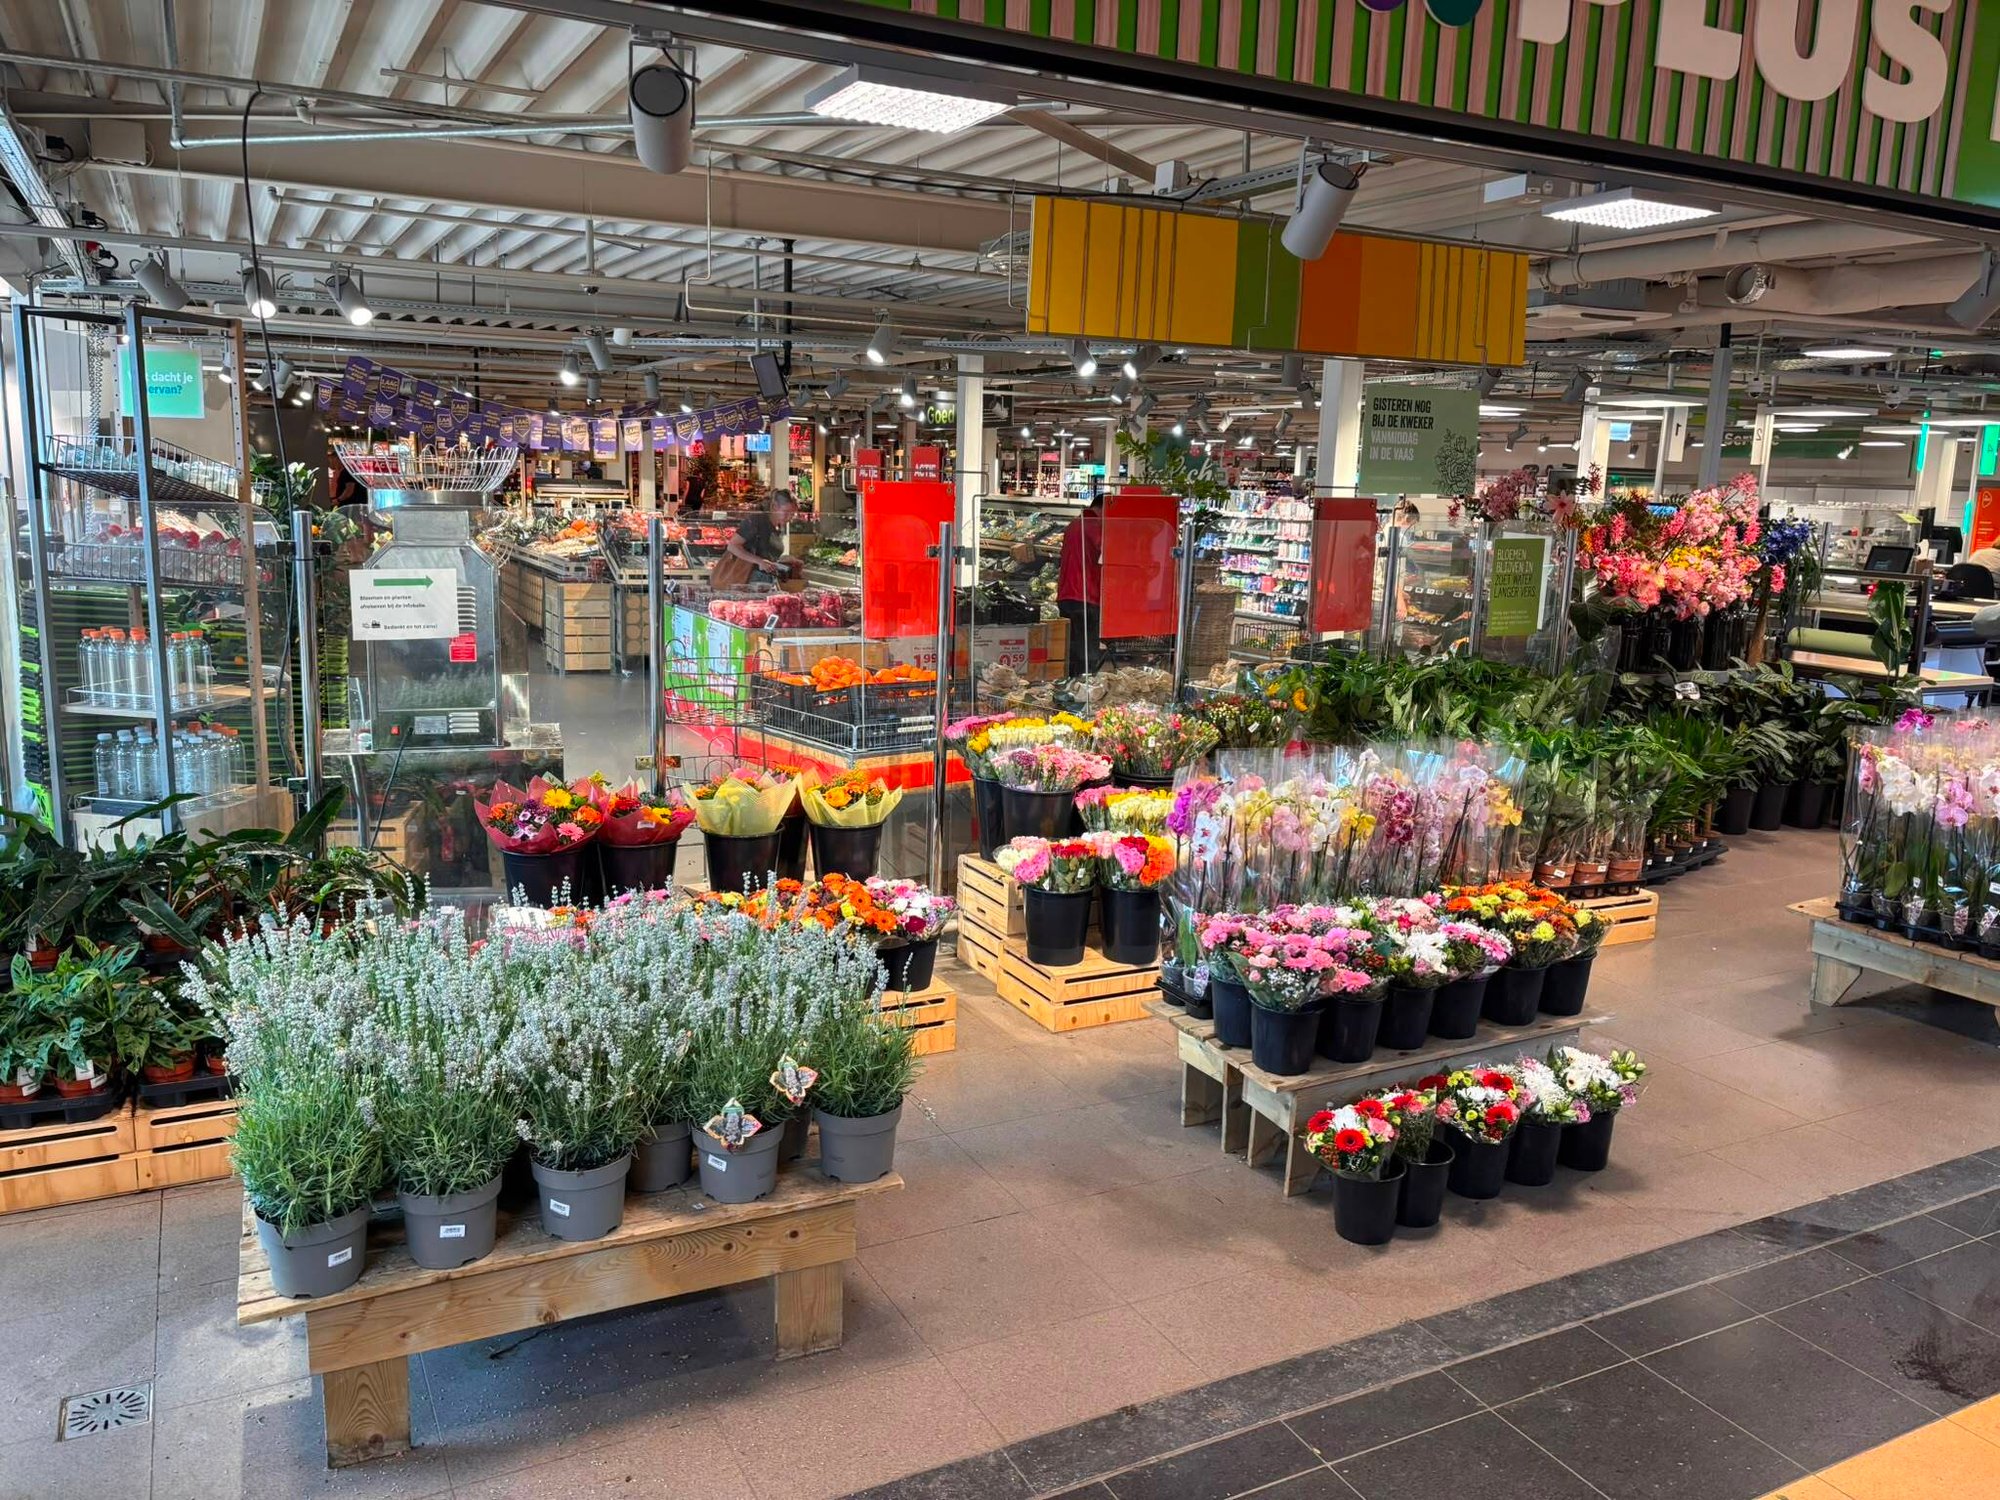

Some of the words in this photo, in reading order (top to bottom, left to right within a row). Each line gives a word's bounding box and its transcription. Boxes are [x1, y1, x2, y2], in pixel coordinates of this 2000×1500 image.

[1518, 0, 1949, 123] LUS
[151, 372, 182, 382] dacht
[183, 372, 194, 384] je
[1373, 397, 1412, 412] GISTEREN
[1414, 400, 1432, 414] NOG
[1372, 414, 1384, 428] BIJ
[1388, 415, 1398, 428] DE
[1400, 416, 1434, 430] KWEKER
[1370, 430, 1418, 445] VANMIDDAG
[1724, 433, 1780, 446] Sere
[1370, 446, 1378, 460] IN
[1380, 446, 1392, 460] DE
[1394, 448, 1414, 461] VAAS
[1497, 548, 1526, 560] BLOEMEN
[1496, 561, 1524, 574] BLIJVEN
[1525, 561, 1534, 573] IN
[1494, 574, 1512, 586] ZOET
[1513, 574, 1532, 586] WATER
[1493, 586, 1520, 599] LANGER
